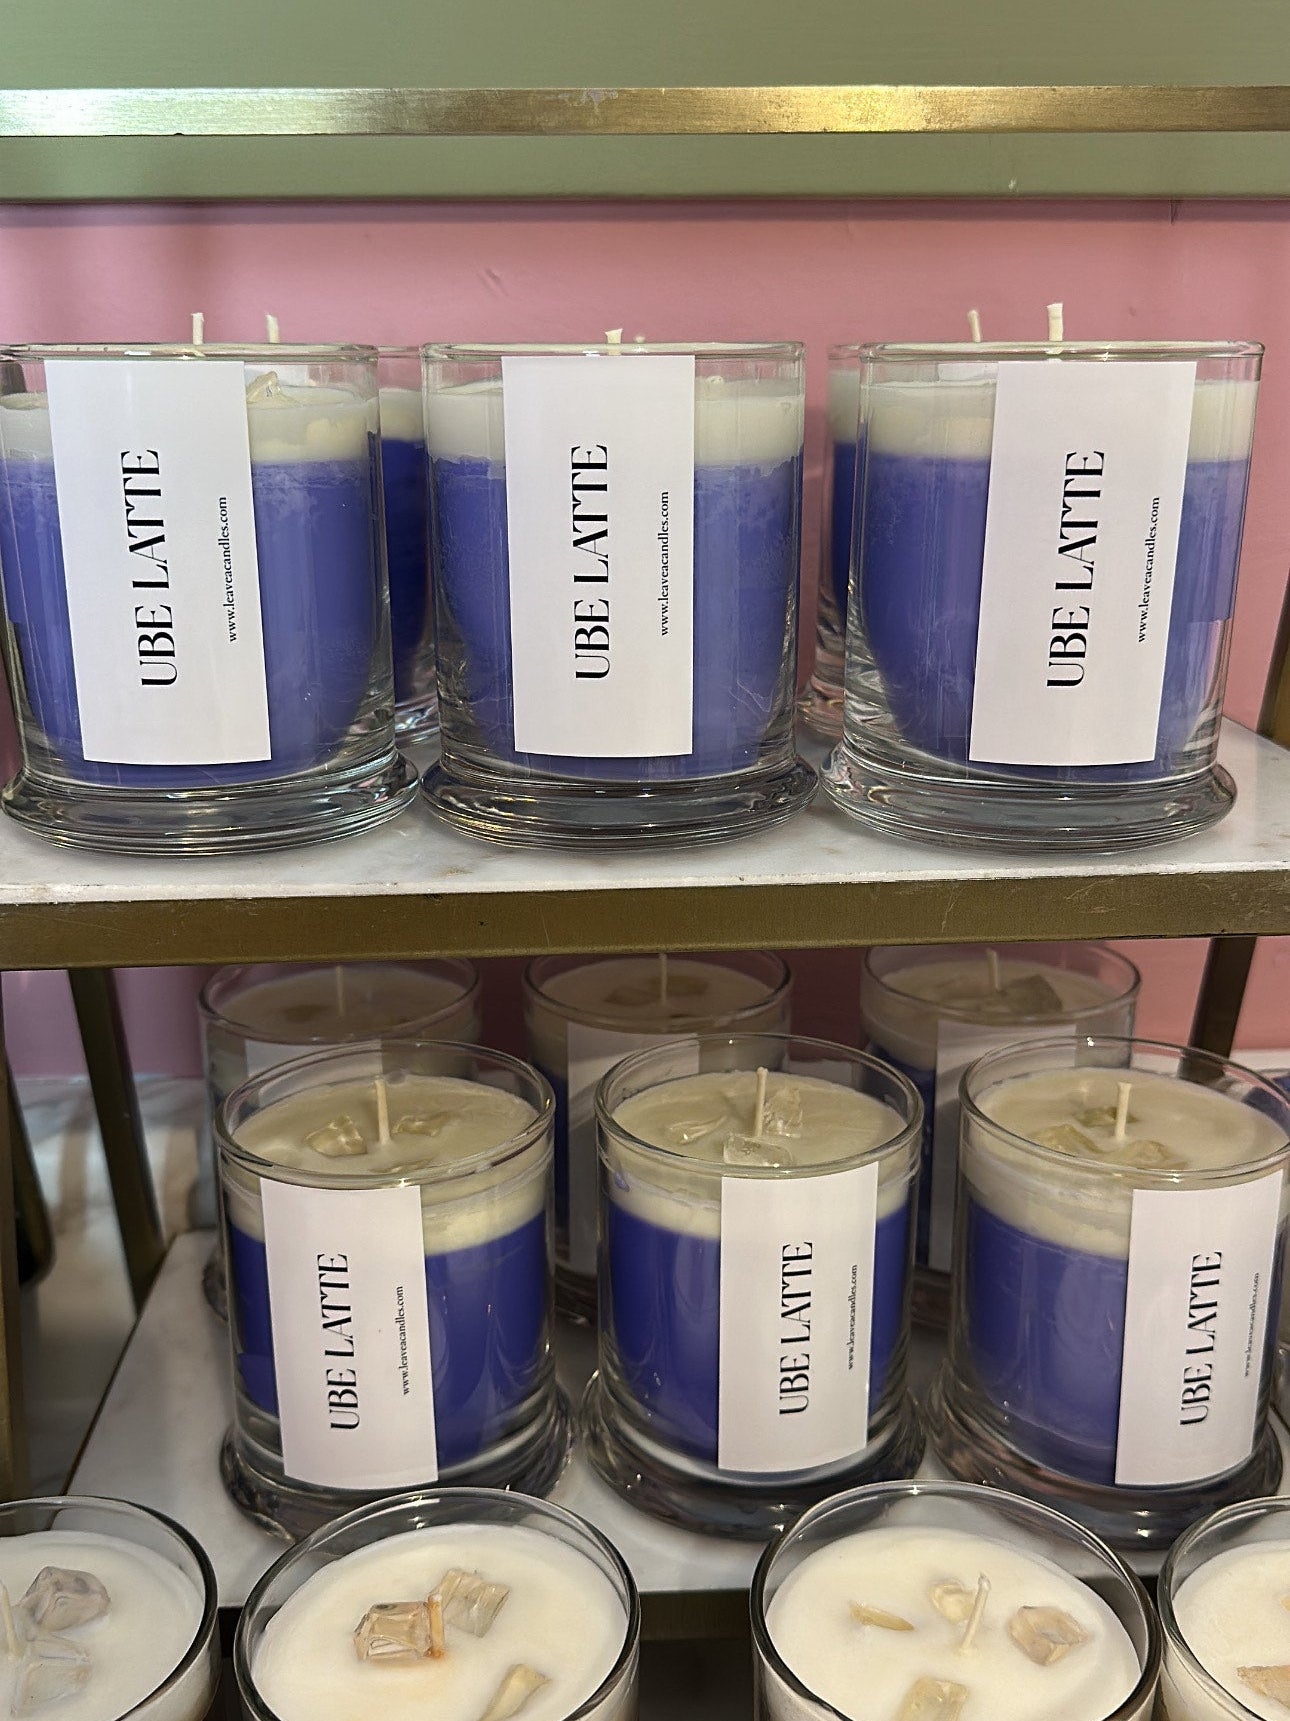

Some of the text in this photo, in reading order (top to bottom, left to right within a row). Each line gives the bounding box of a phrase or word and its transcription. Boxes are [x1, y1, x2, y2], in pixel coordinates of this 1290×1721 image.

[120, 449, 178, 686] UBE LATTE
[217, 496, 238, 643] www.leaveacandles.com
[570, 444, 611, 679] UBE LATTE
[657, 491, 669, 637] www.leaveacandles.com
[1046, 450, 1105, 688] UBE LATTE
[1137, 496, 1160, 643] www.leaveacandles.com
[316, 1253, 361, 1430] UBE LATTE
[394, 1285, 410, 1396] www.leaveacandles.com
[778, 1241, 813, 1416] UBE LATTE
[1179, 1251, 1223, 1426] UBE LATTE
